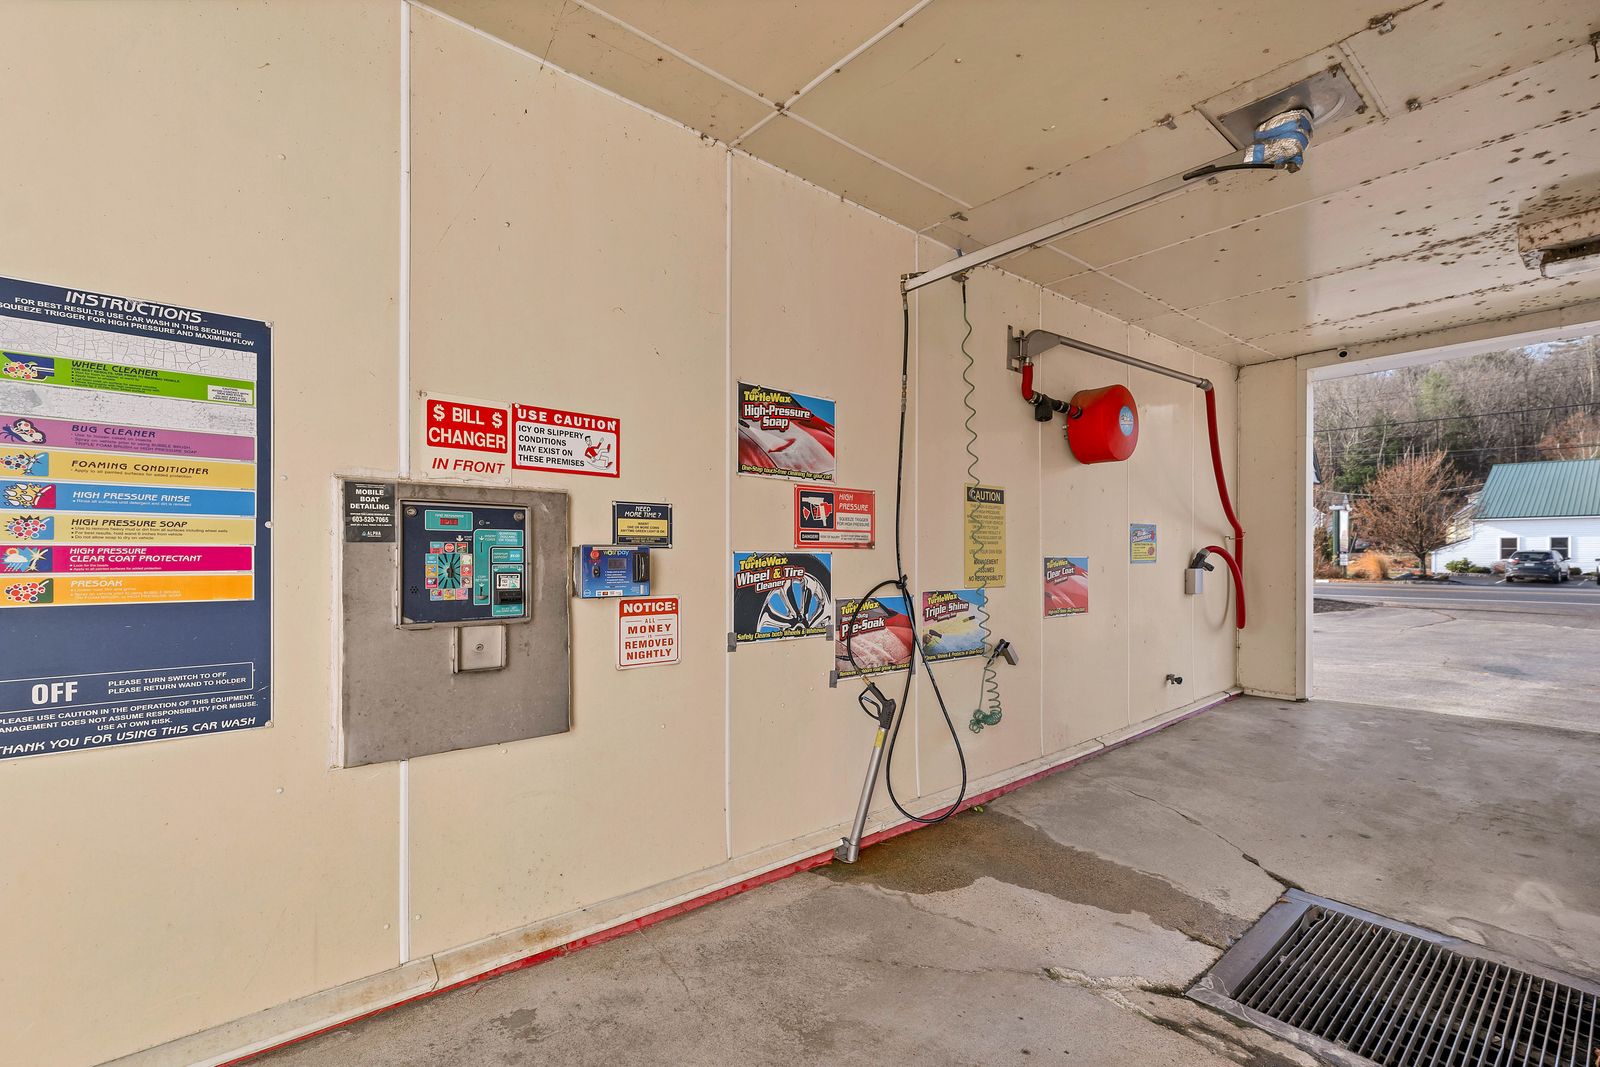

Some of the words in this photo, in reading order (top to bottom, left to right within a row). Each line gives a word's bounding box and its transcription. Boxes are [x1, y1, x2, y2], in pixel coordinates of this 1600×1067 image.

[65, 291, 202, 323] INSTRUCTIONS
[14, 297, 35, 306] FOR
[37, 300, 62, 310] BEST
[64, 305, 104, 317] RESULTS
[106, 312, 124, 320] USE
[146, 318, 170, 327] WASH
[182, 323, 199, 332] THIS
[200, 326, 242, 338] SEQUENCE
[44, 308, 86, 320] TRIGGER
[108, 318, 129, 328] HIGH
[131, 322, 176, 334] PRESSURE
[176, 330, 194, 338] AND
[195, 332, 232, 343] MAXIMUM
[233, 338, 255, 346] FLOW
[72, 360, 108, 371] WHEEL
[111, 365, 158, 377] CLEANER
[433, 404, 446, 422] $
[452, 407, 484, 426] BILL
[492, 412, 503, 428] $
[744, 404, 810, 419] High-Pressure
[517, 408, 547, 422] USE
[554, 414, 616, 431] CAUTION
[762, 416, 788, 428] Soap
[72, 424, 98, 434] BUG
[104, 427, 156, 438] CLEANER
[428, 426, 506, 450] CHANGER
[518, 425, 532, 433] ICY
[547, 429, 584, 440] SLIPPERY
[518, 435, 567, 447] CONDITIONS
[518, 445, 536, 453] MAY
[538, 446, 560, 455] EXIST
[72, 460, 128, 470] FOAMING
[134, 464, 209, 475] CONDITIONER
[432, 458, 448, 470] IN
[453, 459, 506, 474] FRONT
[518, 454, 543, 464] THESE
[546, 456, 585, 467] PREMISES
[72, 491, 100, 500] HIGH
[103, 492, 158, 501] PRESSURE
[160, 495, 191, 503] RINSE
[969, 489, 1001, 502] CAUTION
[839, 503, 869, 511] PRESSURE
[102, 519, 157, 528] PRESSURE
[737, 569, 770, 586] Wheel
[773, 568, 781, 579] &
[785, 568, 804, 577] Tire
[1047, 570, 1061, 580] Clear
[70, 580, 122, 588] PRESOAK
[756, 580, 785, 591] Cleaner
[624, 602, 676, 613] NOTICE:
[841, 601, 879, 614] TurtlWax
[925, 605, 946, 618] Triple
[948, 602, 968, 612] Shine
[628, 624, 671, 634] MONEY
[842, 618, 885, 637] Pe-Soak
[625, 638, 674, 650] REMOVED
[627, 648, 672, 660] NIGHTLY
[108, 678, 142, 687] PLEASE
[168, 674, 198, 682] SWITCH
[32, 681, 78, 704] OFF
[108, 686, 142, 695] PLEASE
[144, 684, 177, 692] RETURN
[58, 709, 98, 718] CAUTION
[130, 702, 177, 712] OPERATION
[210, 694, 255, 704] EQUIPMENT.
[0, 722, 59, 733] ANAGEMENT
[108, 712, 144, 722] ASSUME
[146, 706, 210, 718] RESPONSIBILITY
[229, 701, 258, 709] MISUSE.
[50, 737, 80, 749] YOU
[84, 734, 112, 745] FOR
[116, 728, 157, 741] USING
[162, 724, 188, 736] THIS
[192, 721, 218, 732] CAR
[221, 716, 256, 728] WASH
